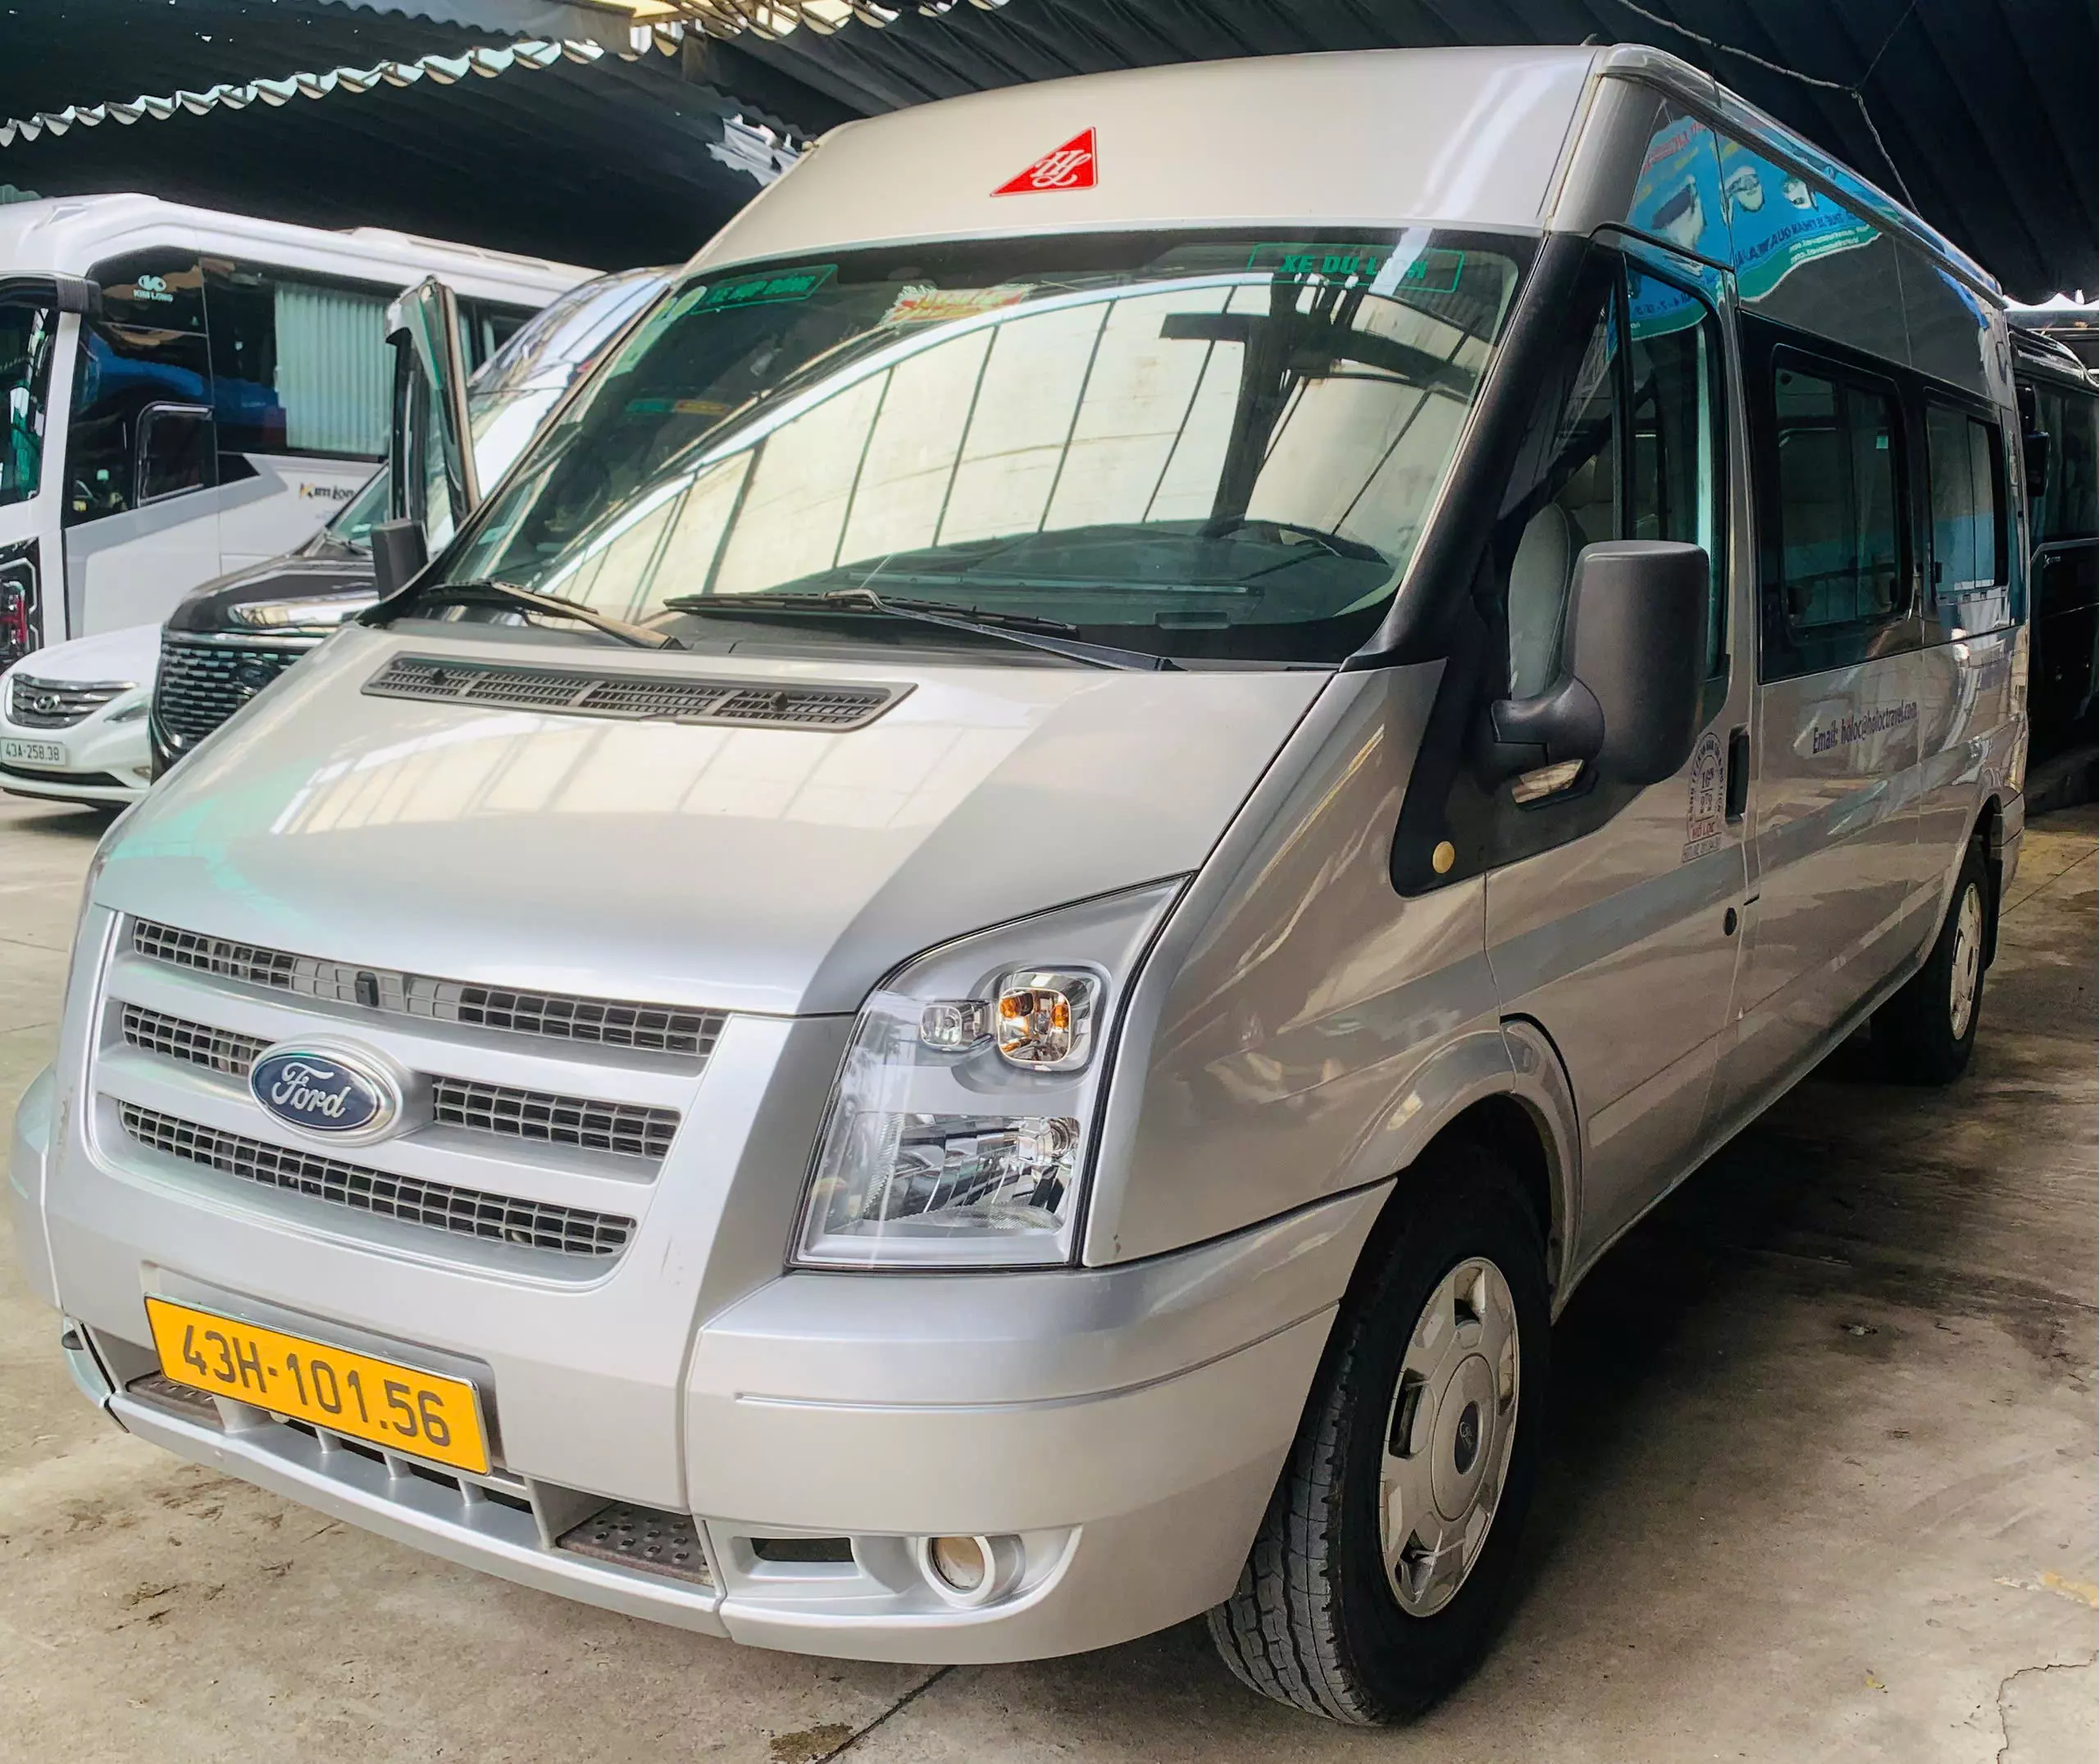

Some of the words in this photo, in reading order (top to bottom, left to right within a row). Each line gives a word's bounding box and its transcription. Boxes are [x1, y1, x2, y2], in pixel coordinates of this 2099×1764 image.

[1279, 255, 1315, 273] XE
[1321, 256, 1359, 275] DU
[271, 1062, 349, 1120] Ford
[182, 1324, 450, 1447] 43H-101.56
